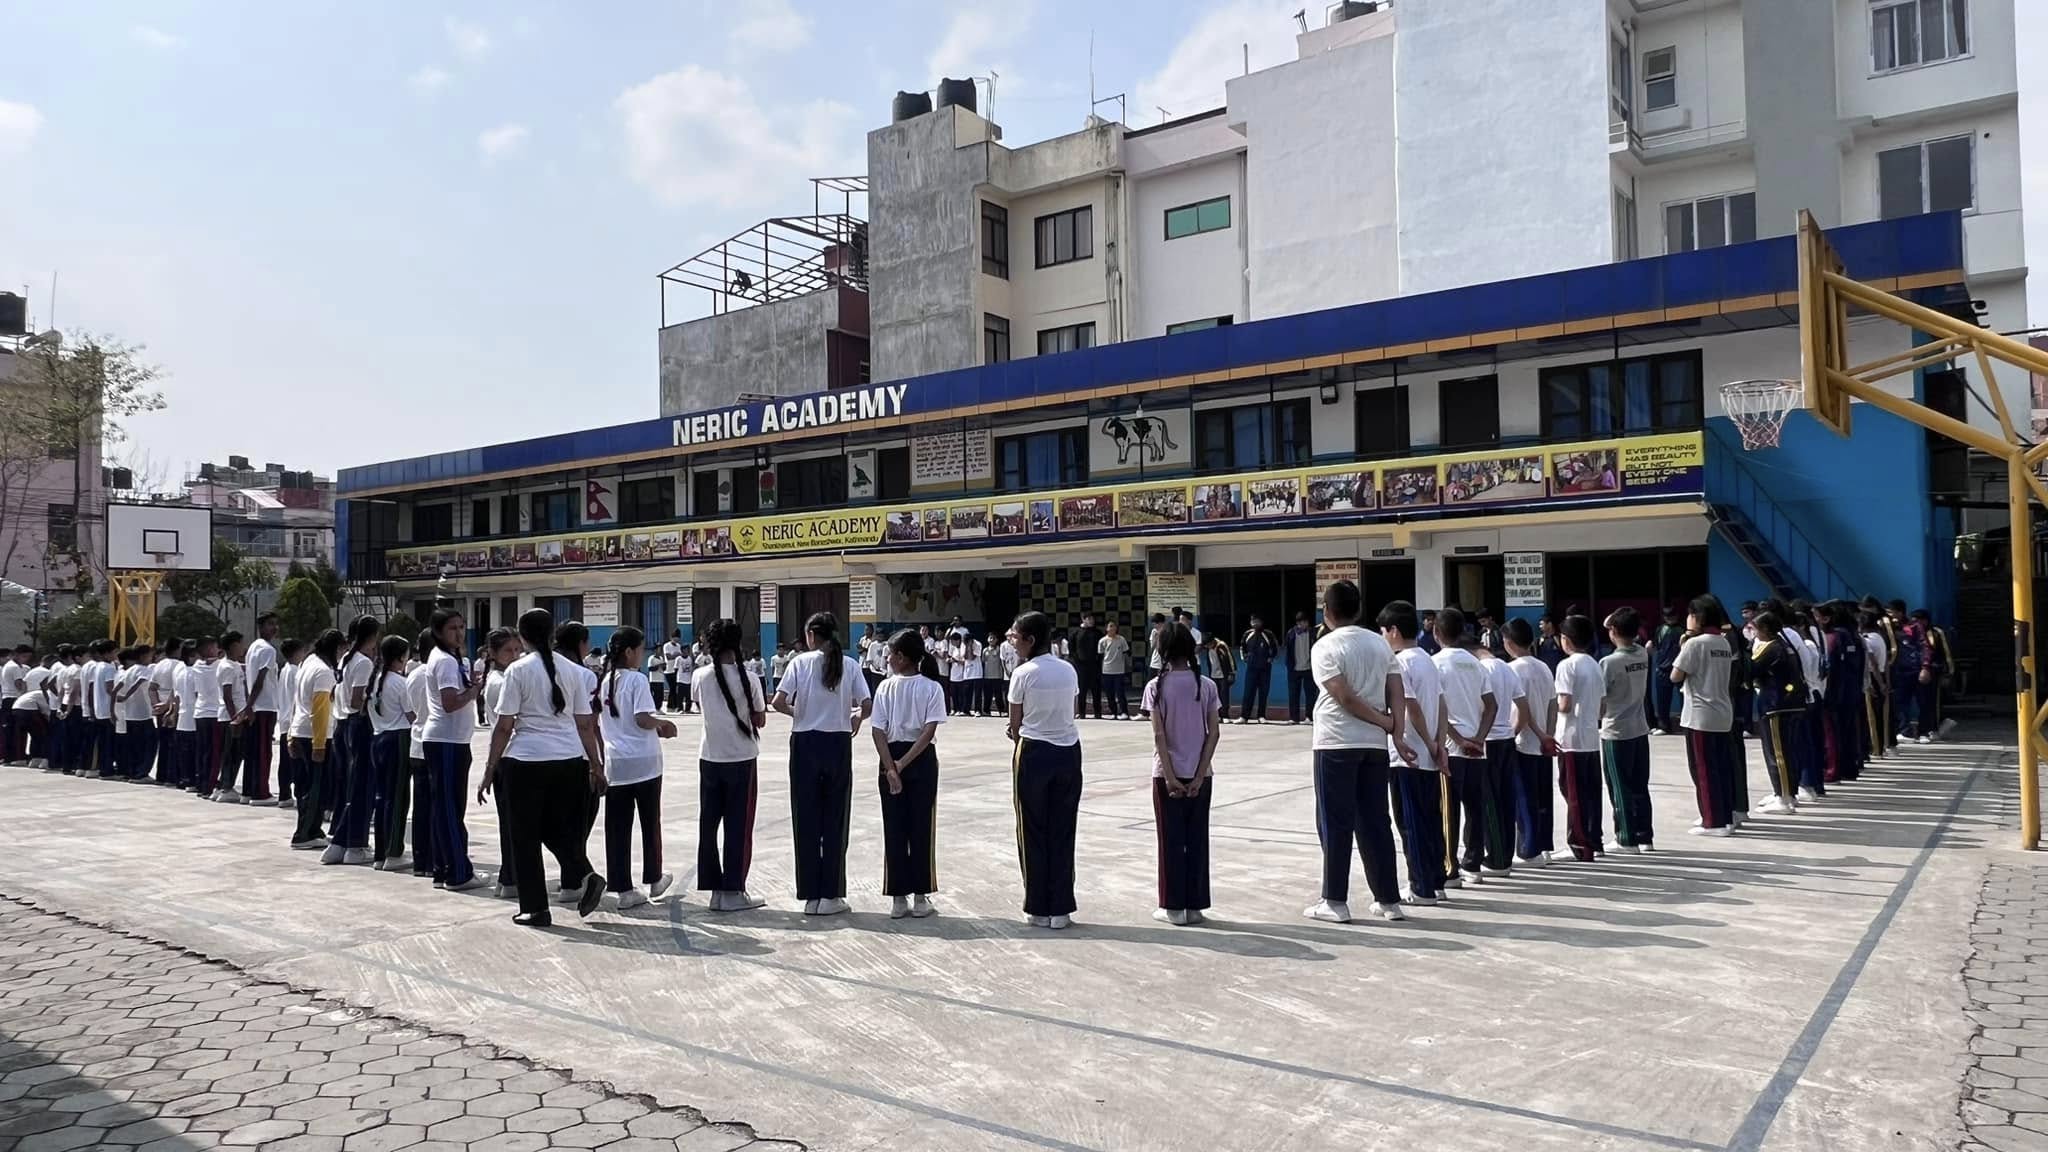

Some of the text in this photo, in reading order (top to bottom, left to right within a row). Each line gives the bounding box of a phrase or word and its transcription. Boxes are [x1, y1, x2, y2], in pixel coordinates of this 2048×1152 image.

[673, 383, 908, 447] NERIC ACADEMY
[1625, 444, 1697, 455] EVERYTHING
[1625, 451, 1697, 462] HAS BEAUTY
[1625, 461, 1674, 471] BUT NOT
[1625, 467, 1688, 478] EVERY ONE
[1657, 476, 1668, 484] IT
[762, 516, 881, 541] NERIC ACADEMY
